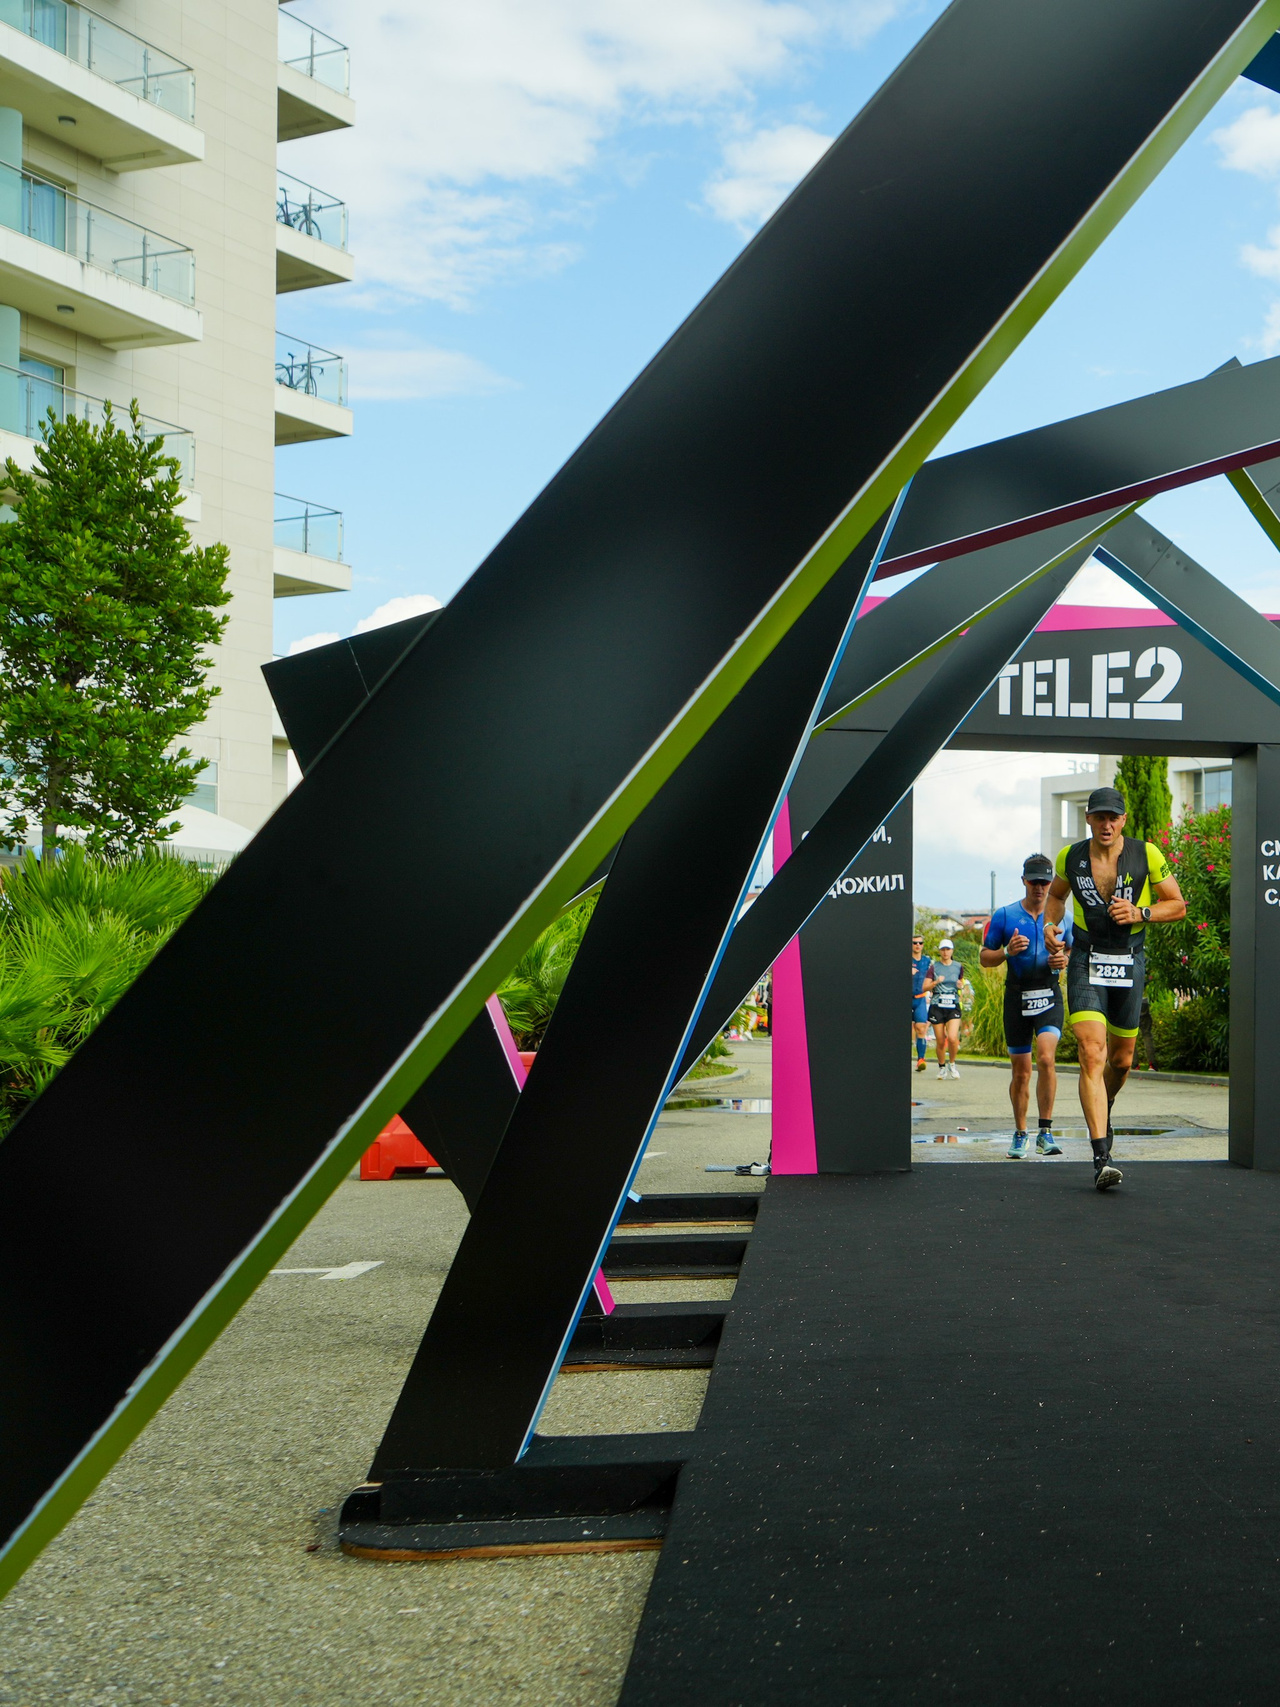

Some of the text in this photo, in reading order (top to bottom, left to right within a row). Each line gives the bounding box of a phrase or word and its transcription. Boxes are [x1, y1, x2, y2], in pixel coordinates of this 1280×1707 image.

[998, 646, 1183, 721] TELE2
[828, 874, 905, 898] ЮЖИЛ
[1096, 964, 1126, 978] 2824
[1027, 997, 1049, 1010] 2780
